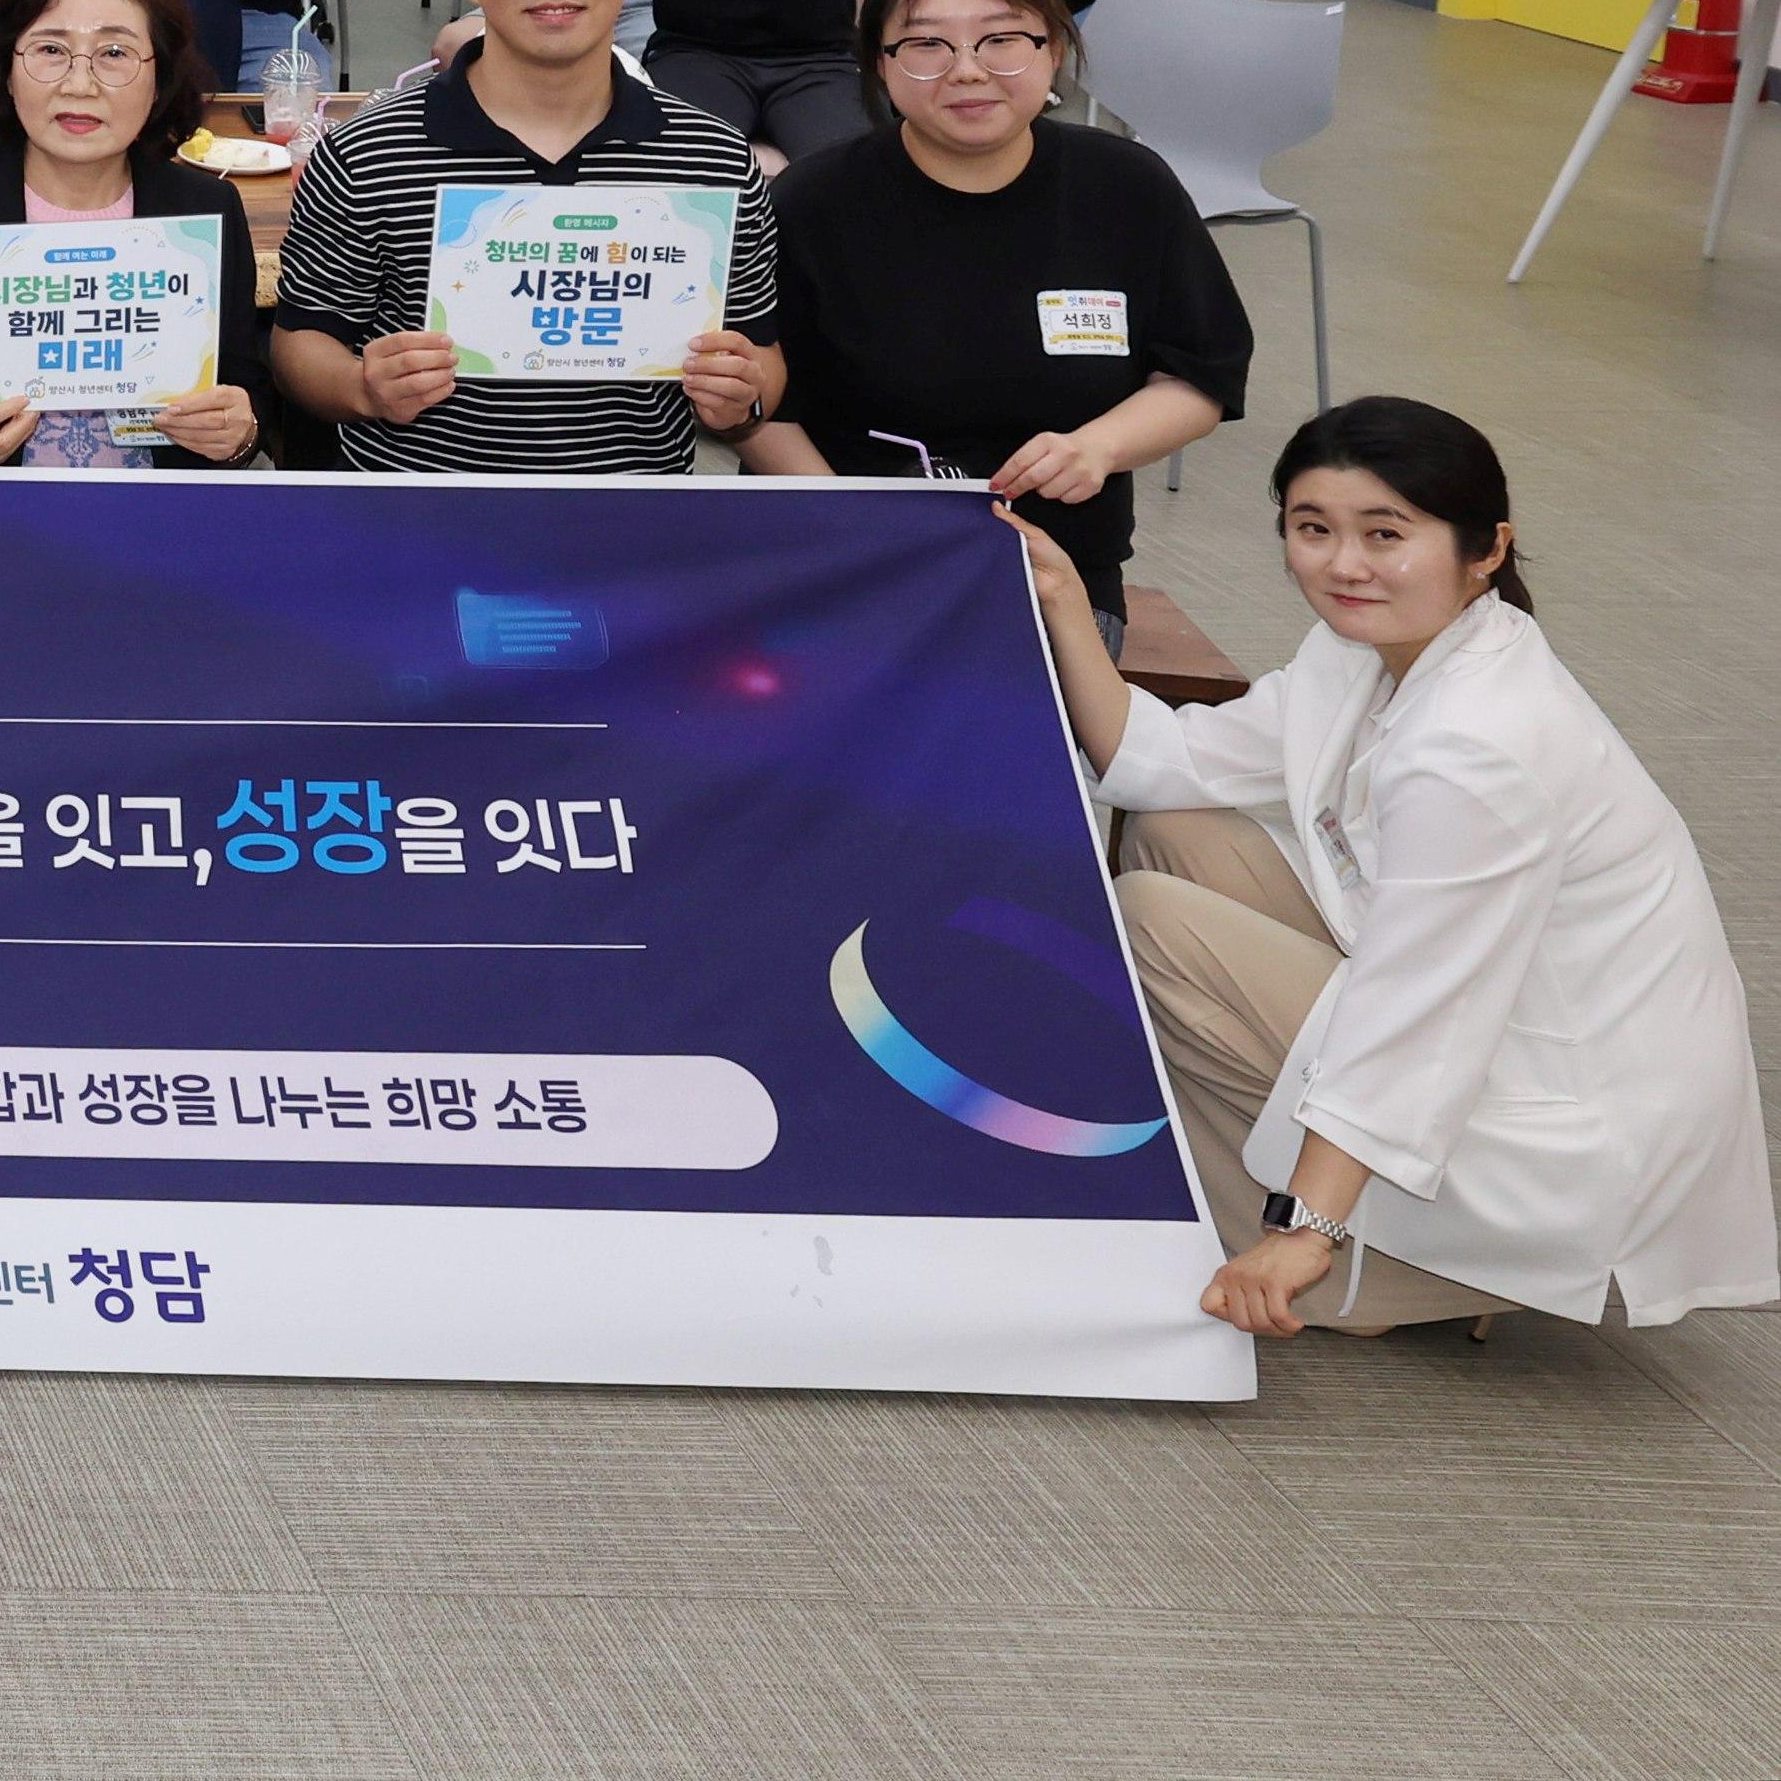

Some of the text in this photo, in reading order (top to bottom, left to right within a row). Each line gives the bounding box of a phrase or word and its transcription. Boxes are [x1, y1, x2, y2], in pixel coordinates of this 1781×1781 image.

[484, 239, 687, 264] 청년의 꿈에 힘이 되는
[105, 270, 189, 302] 청년이
[511, 269, 652, 303] 시장님의
[8, 307, 161, 337] 함께 그리는
[531, 306, 623, 347] 방문
[1063, 311, 1112, 330] 석희정
[38, 339, 123, 372] 미래
[606, 356, 626, 369] 청담
[115, 382, 137, 394] 청담
[483, 794, 640, 877] 잇다
[77, 1072, 218, 1129] 성장을
[233, 1075, 374, 1132] 나누는
[387, 1077, 479, 1134] 희망
[492, 1078, 588, 1138] 소통
[67, 1247, 211, 1326] 청담
